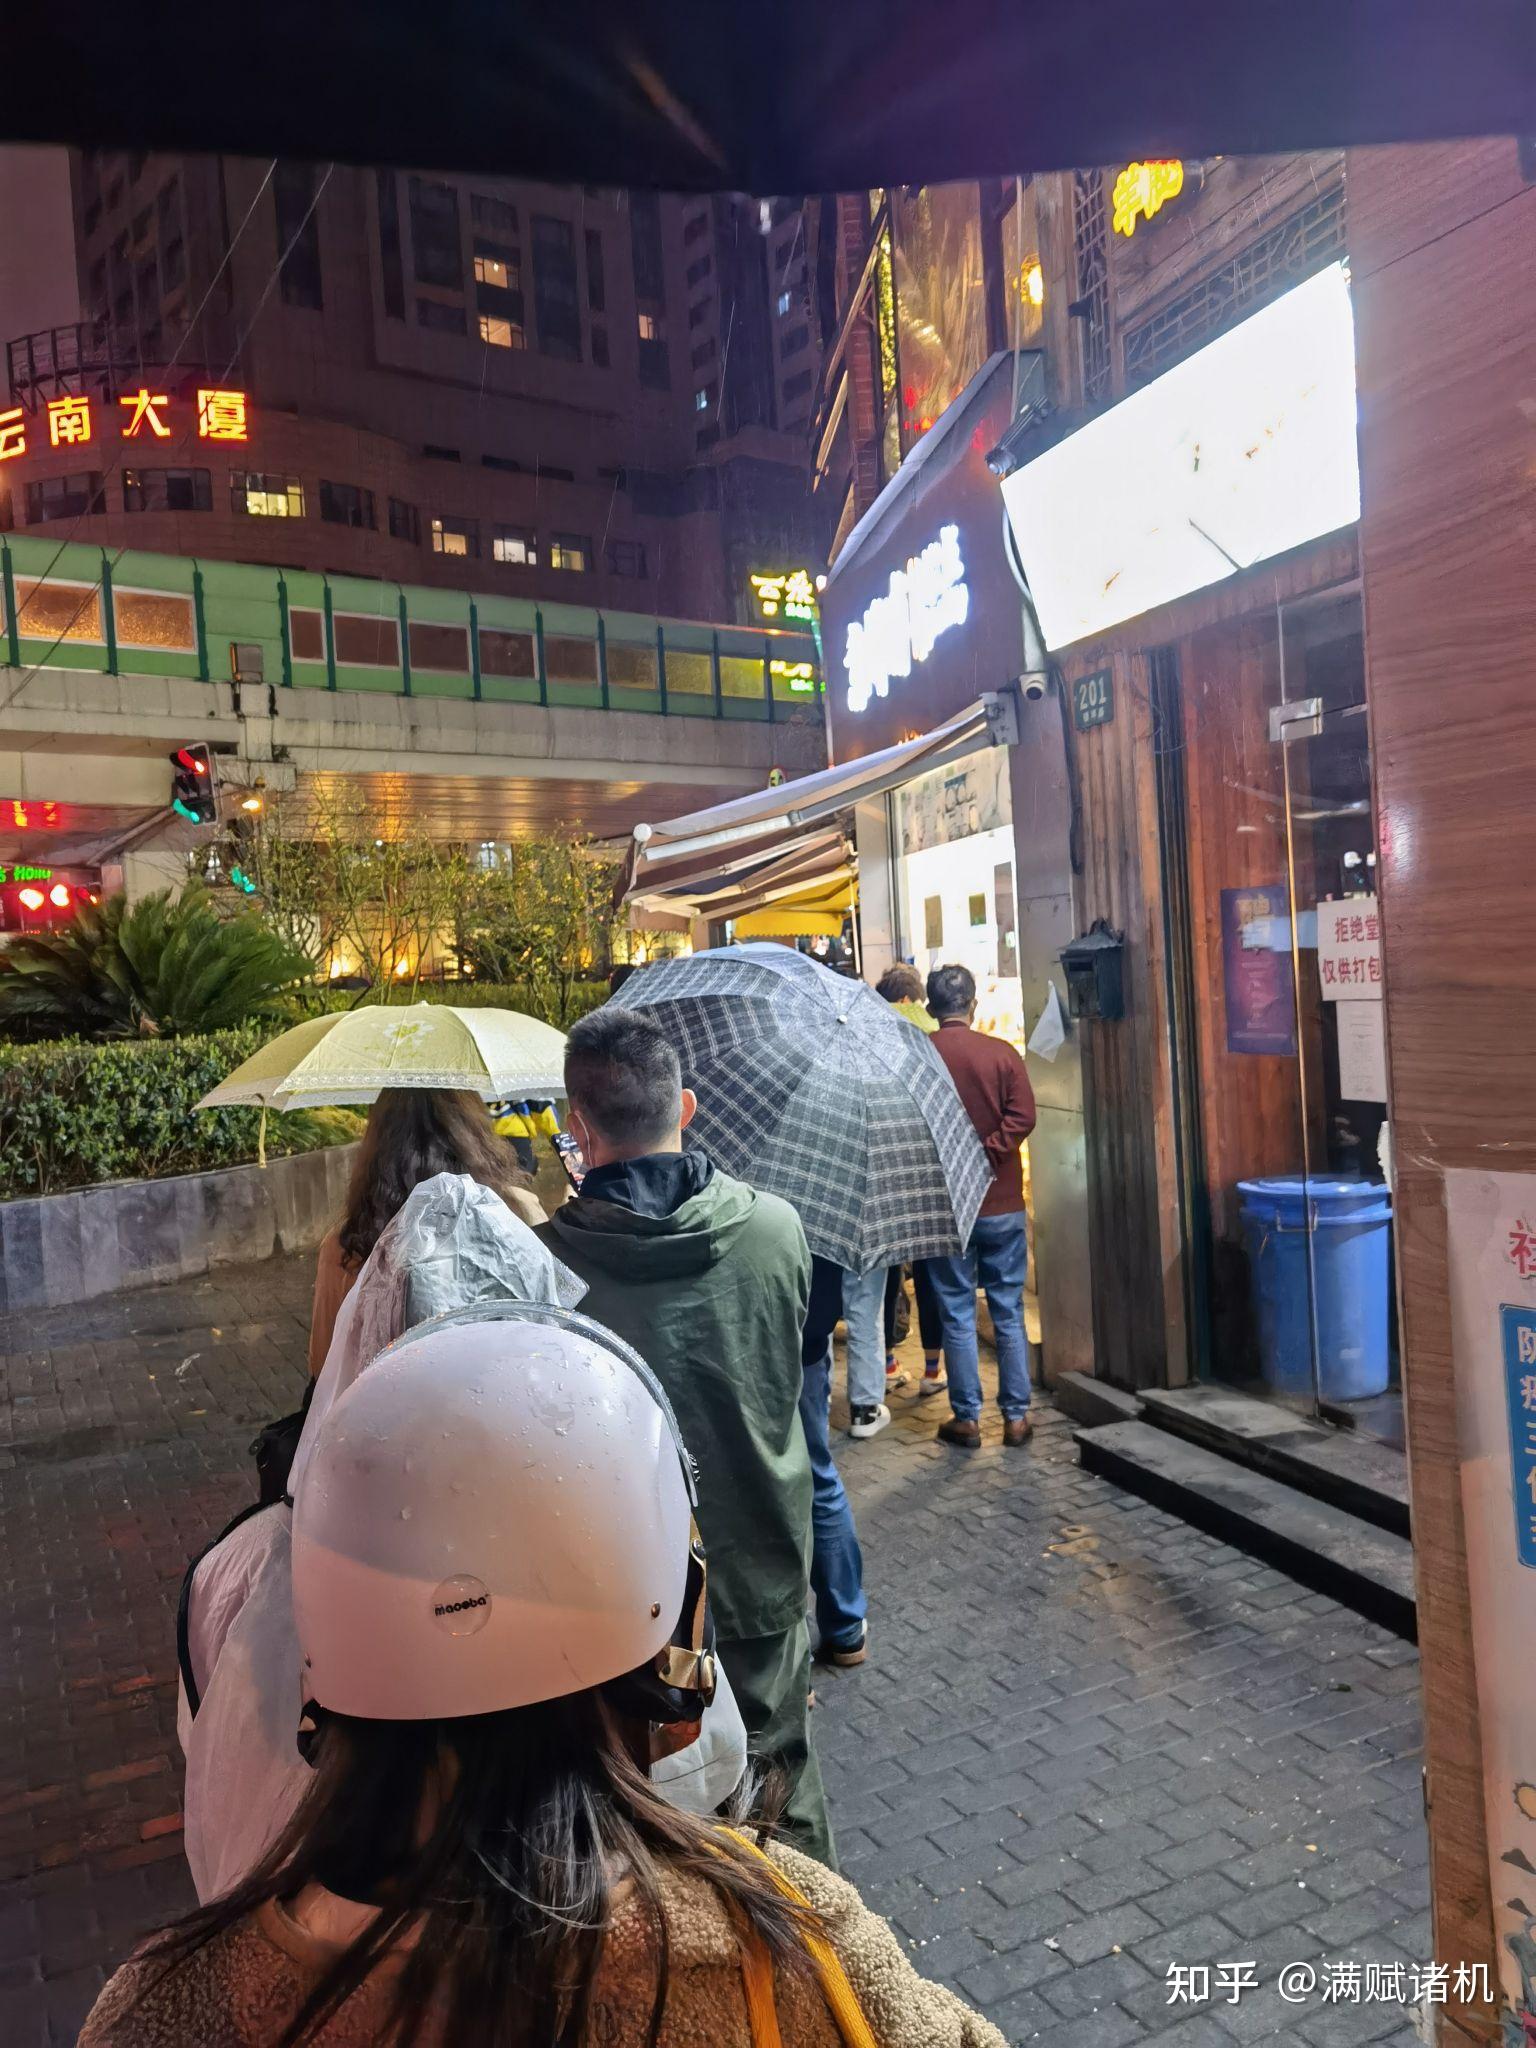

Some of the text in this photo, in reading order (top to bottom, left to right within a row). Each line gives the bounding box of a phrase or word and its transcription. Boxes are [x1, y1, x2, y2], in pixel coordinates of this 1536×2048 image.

[0, 388, 249, 459] 云南大厦
[1079, 677, 1106, 711] 201
[1322, 955, 1382, 984] 仅供打包
